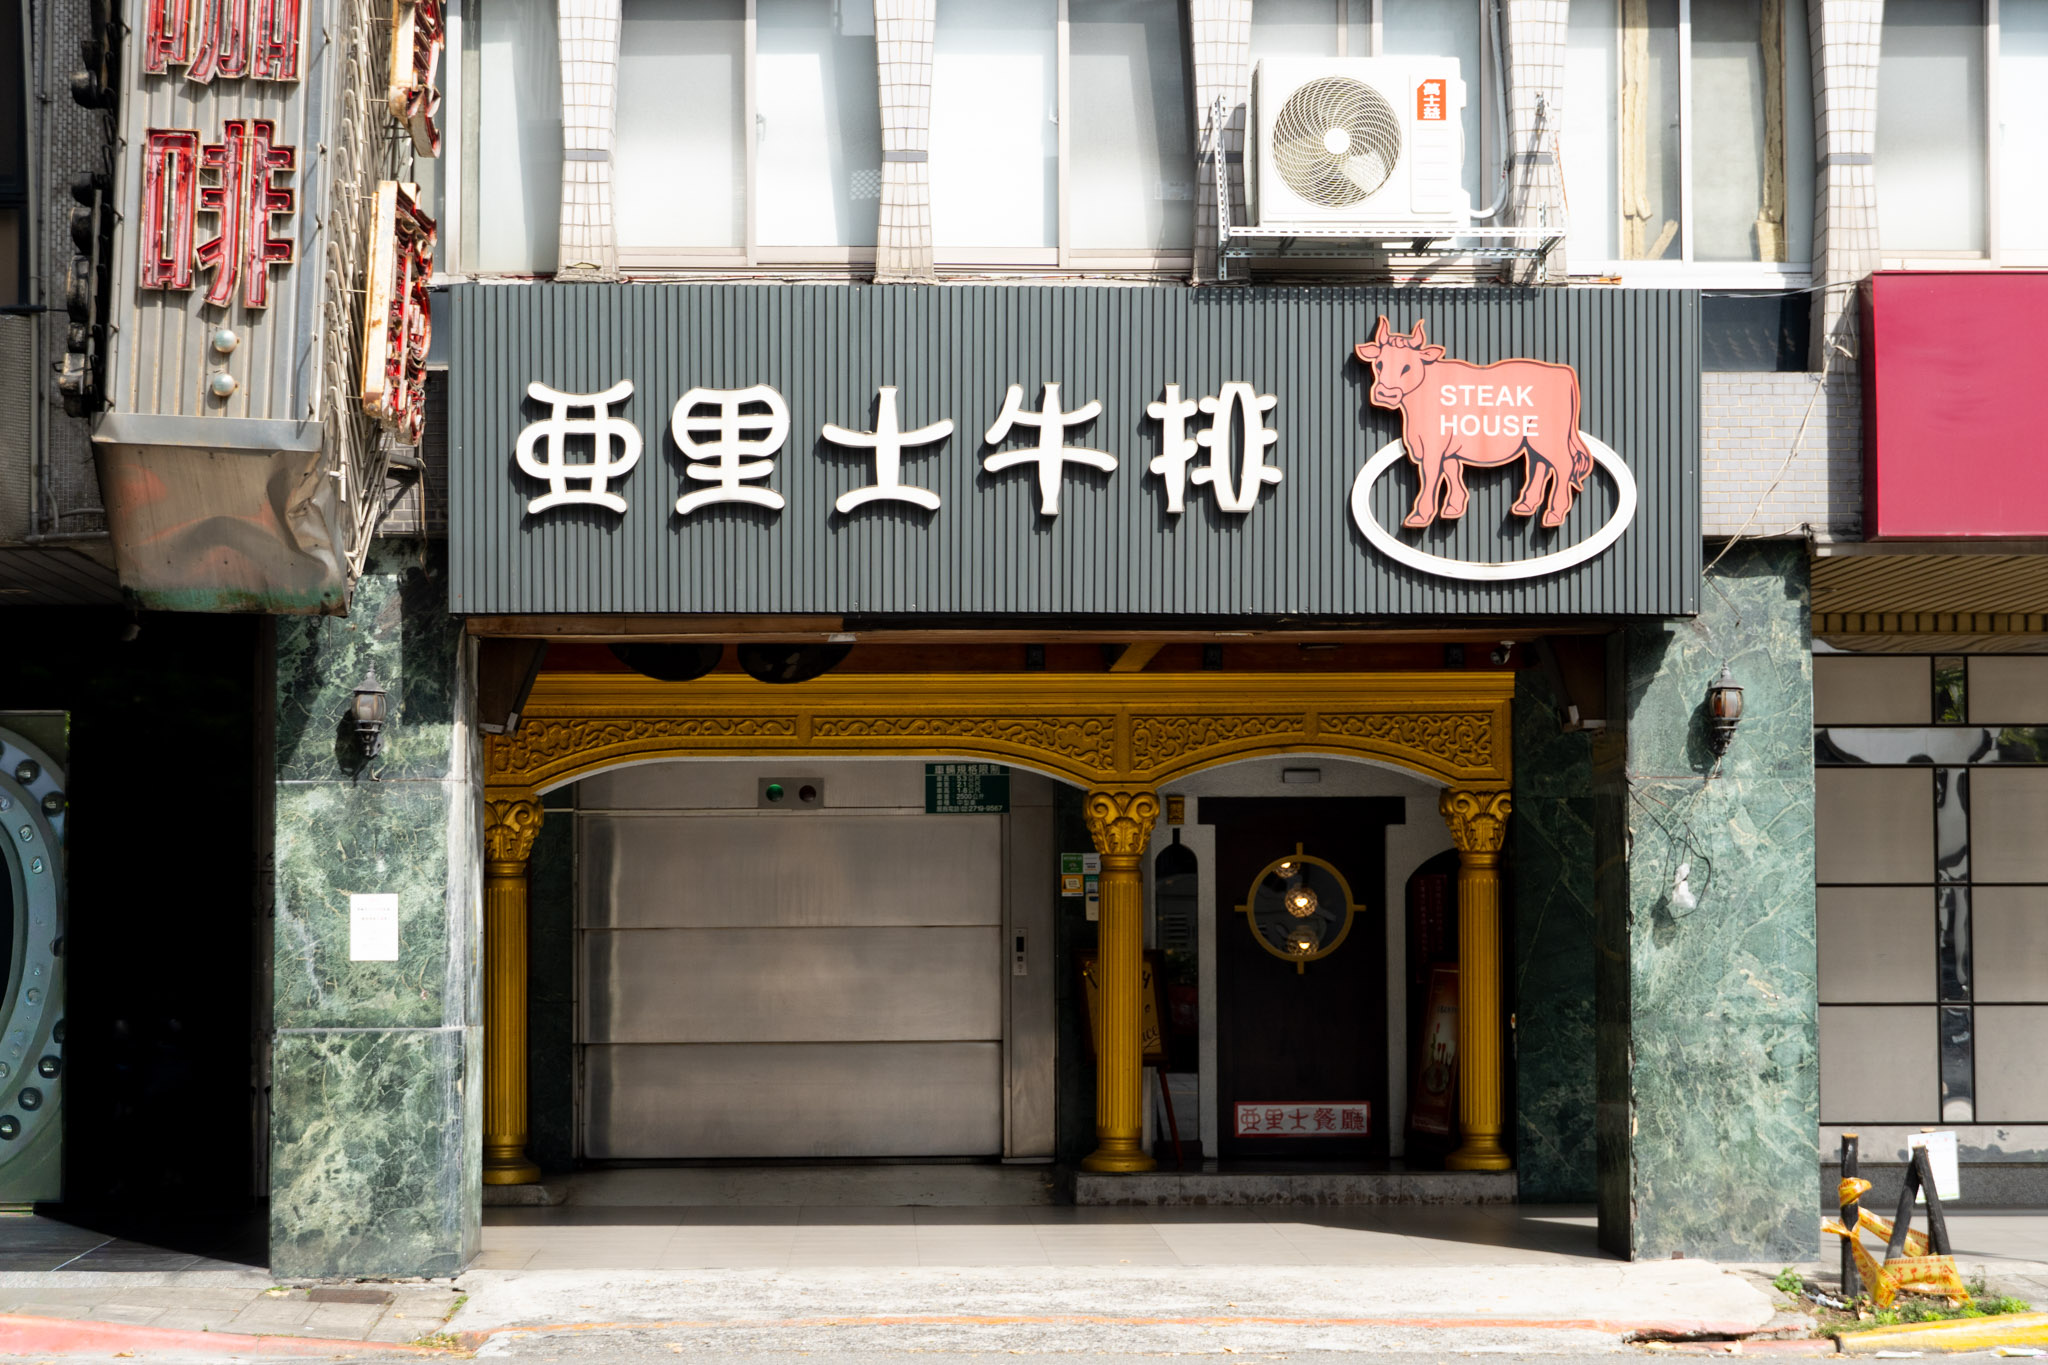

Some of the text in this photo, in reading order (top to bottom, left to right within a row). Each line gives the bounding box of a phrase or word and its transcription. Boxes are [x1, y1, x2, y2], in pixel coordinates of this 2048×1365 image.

[1423, 82, 1441, 119] 萬士益
[1439, 384, 1535, 407] STEAK
[1439, 413, 1540, 437] HOUSE
